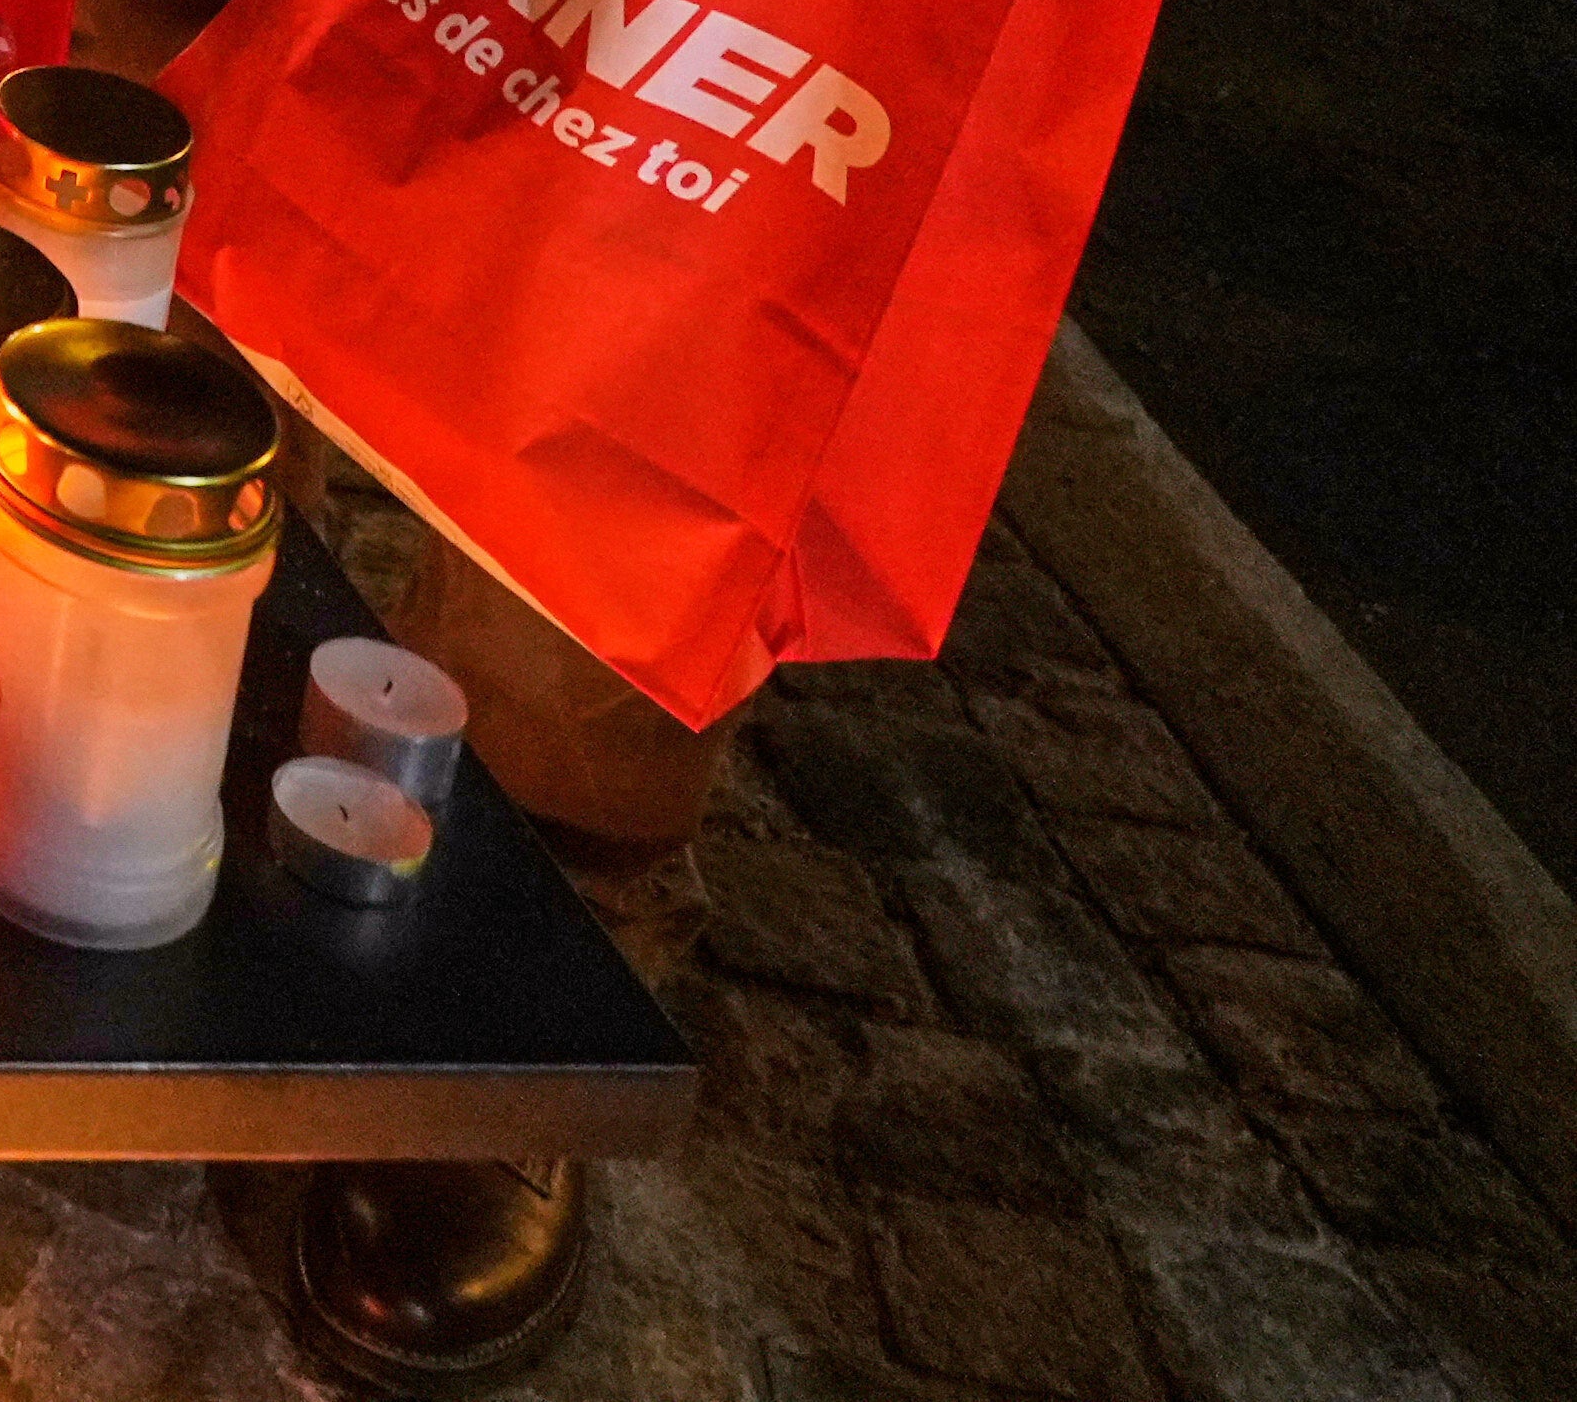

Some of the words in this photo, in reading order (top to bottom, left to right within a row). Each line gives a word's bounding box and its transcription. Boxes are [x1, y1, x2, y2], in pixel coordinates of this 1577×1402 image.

[434, 11, 505, 76] de
[501, 65, 637, 168] chez
[635, 138, 751, 214] toi
